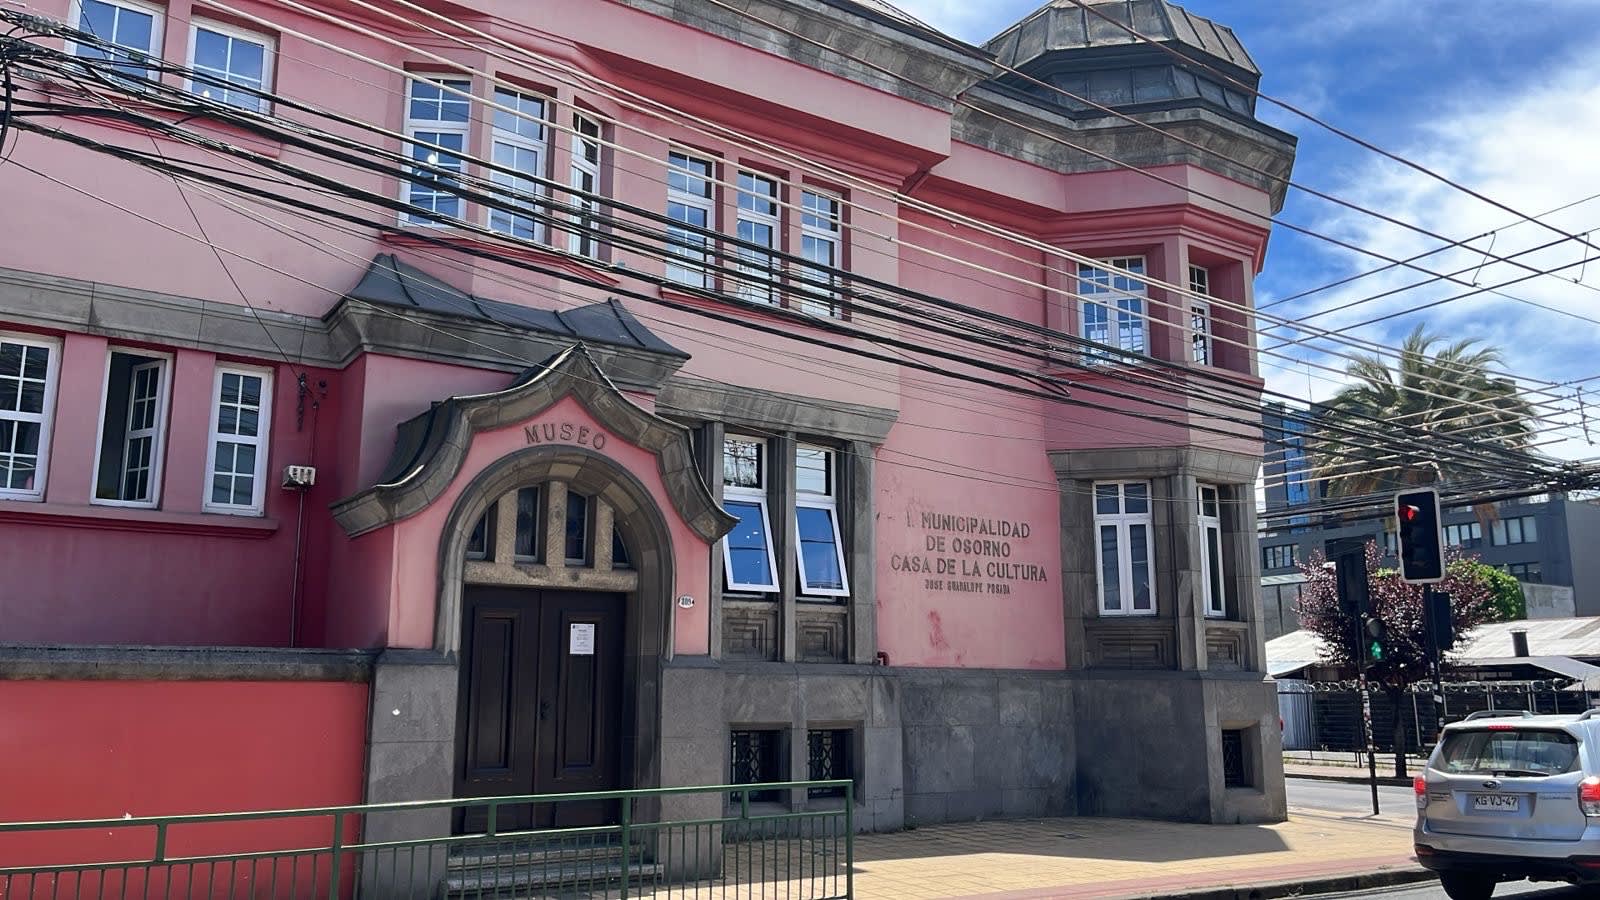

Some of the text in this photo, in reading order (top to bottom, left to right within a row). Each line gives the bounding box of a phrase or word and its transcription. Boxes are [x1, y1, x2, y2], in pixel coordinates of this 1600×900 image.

[524, 422, 605, 450] MUSEO
[921, 512, 1030, 538] MUNICIPALIDAD
[926, 535, 1010, 557] DE OSORNO
[891, 554, 1047, 582] CASA DE LA CULTURA
